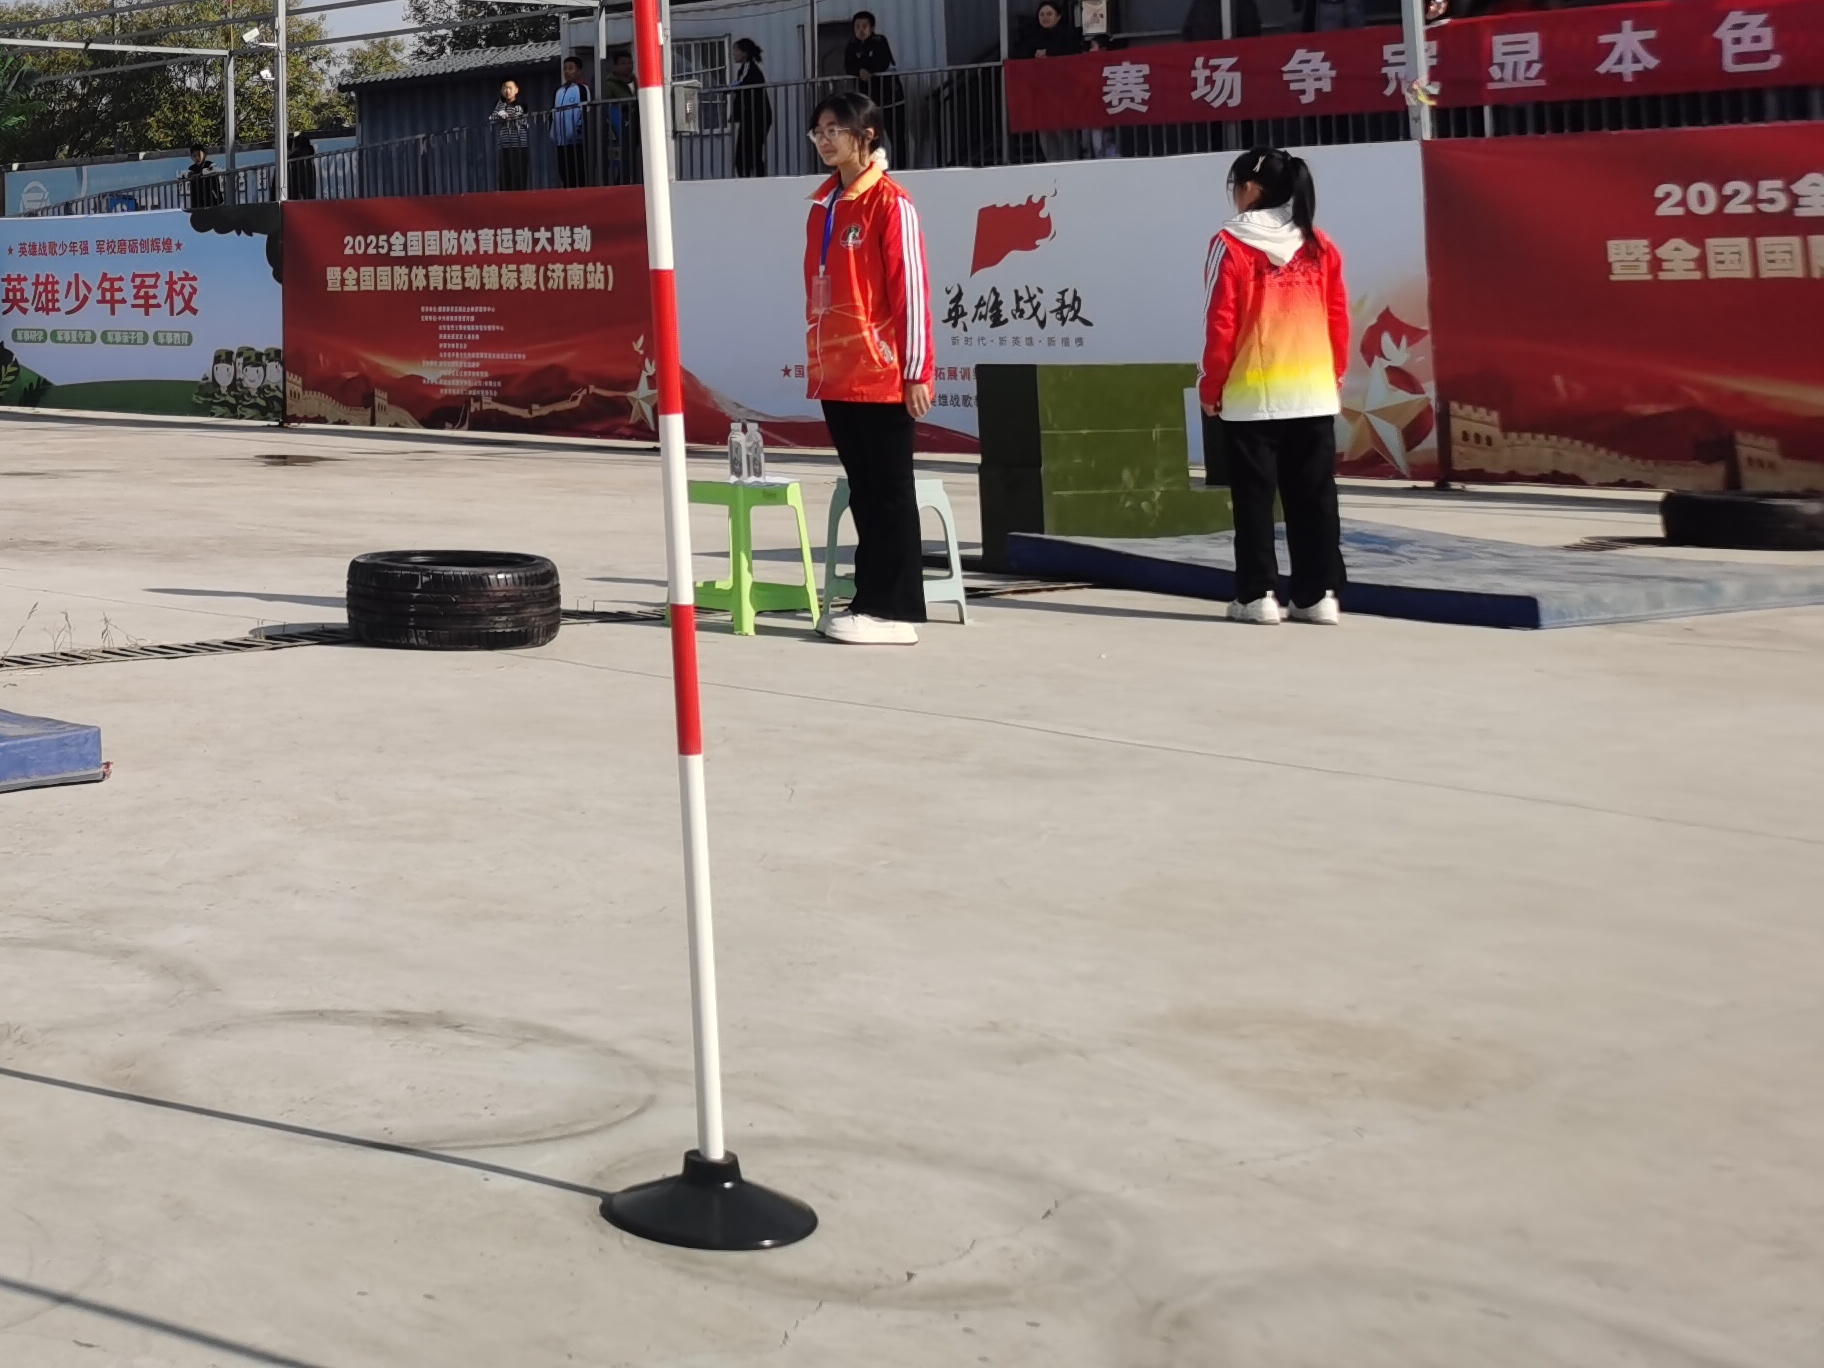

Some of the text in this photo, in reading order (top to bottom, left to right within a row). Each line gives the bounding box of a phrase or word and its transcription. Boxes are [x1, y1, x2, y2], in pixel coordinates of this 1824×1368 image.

[1102, 10, 1782, 114] 赛场争冠显本色
[18, 239, 90, 258] 英雄战歌少年强
[343, 225, 592, 257] 2025全国国防体育运动大联动
[0, 270, 199, 317] 英雄少年军校
[942, 283, 1094, 332] 英雄战歌
